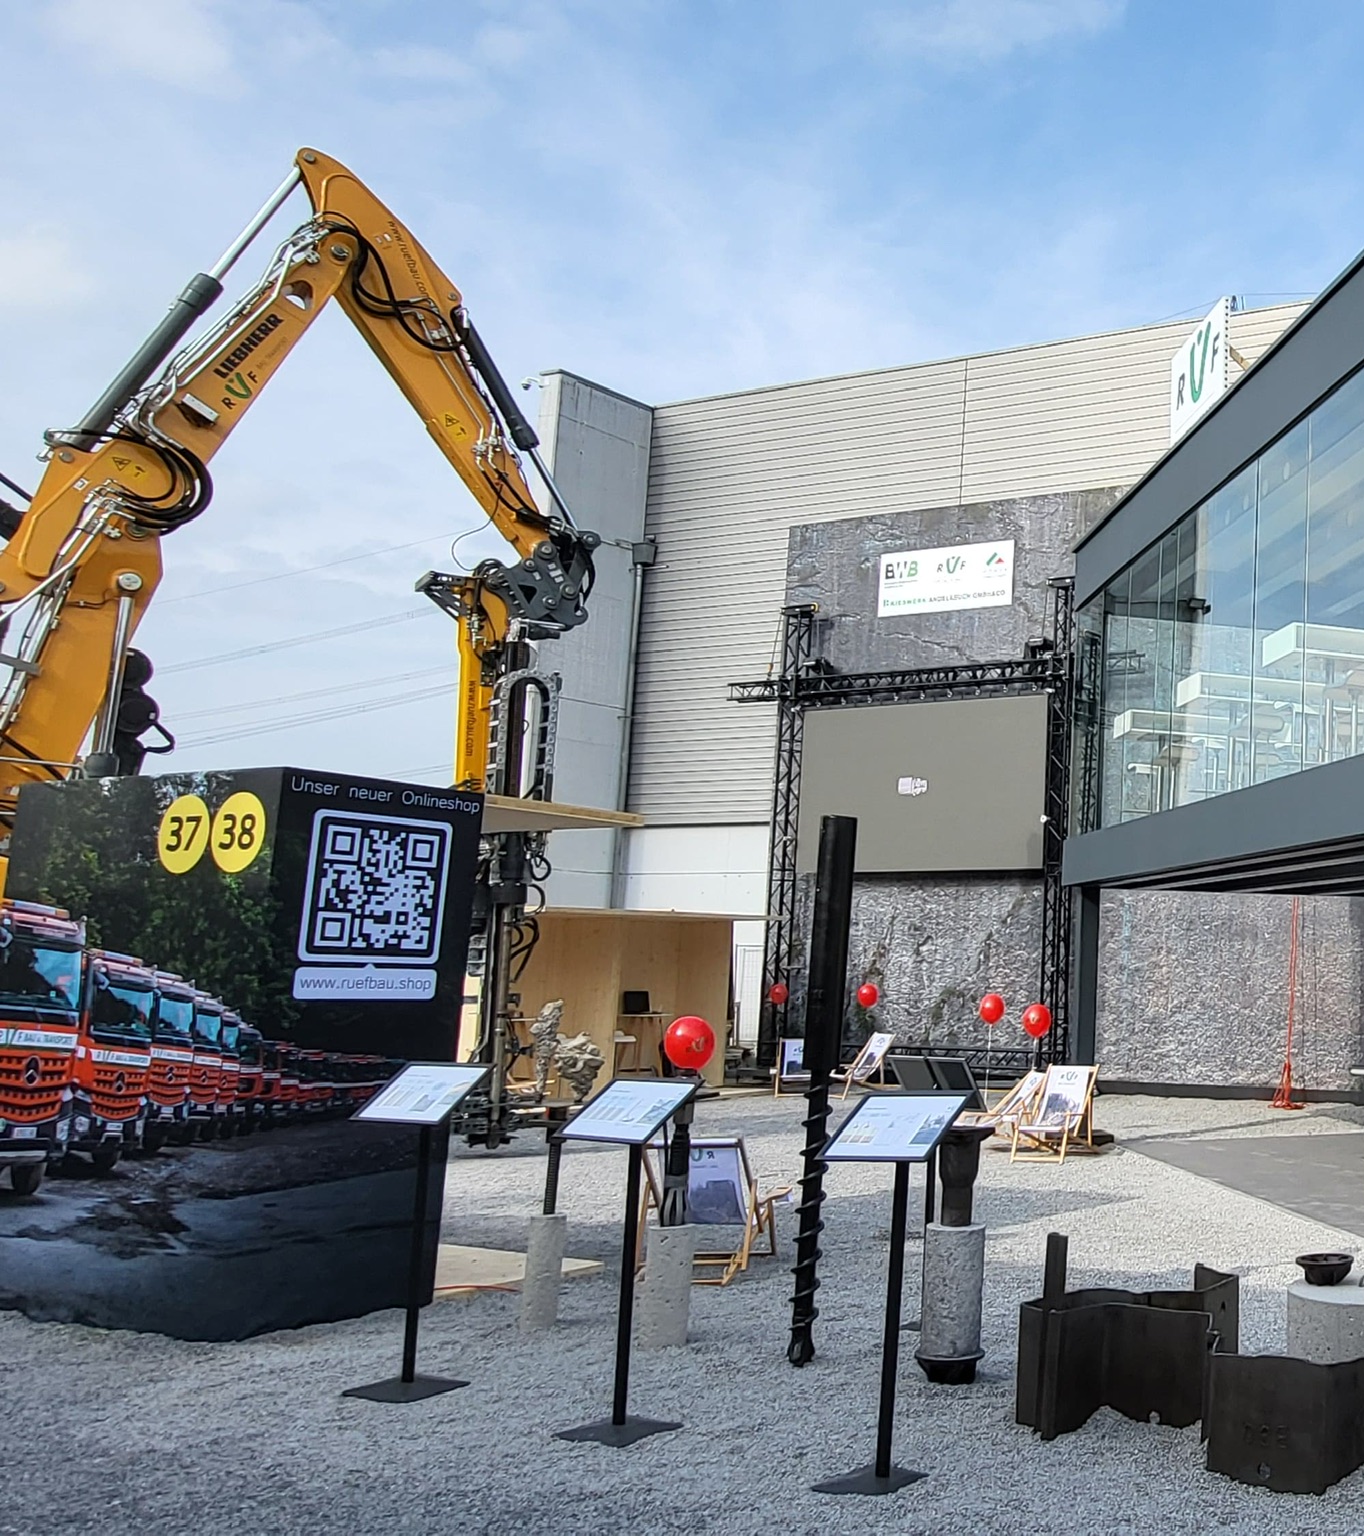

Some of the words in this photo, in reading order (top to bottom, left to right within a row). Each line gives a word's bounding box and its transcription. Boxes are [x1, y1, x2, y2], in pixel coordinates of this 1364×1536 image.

[213, 313, 285, 379] LIEBHERR
[291, 775, 340, 796] Unser
[349, 786, 393, 802] neuer
[402, 790, 481, 815] Onlineshop
[165, 815, 203, 852] 37
[218, 813, 256, 850] 38
[300, 976, 432, 992] www.ruefbau.shop
